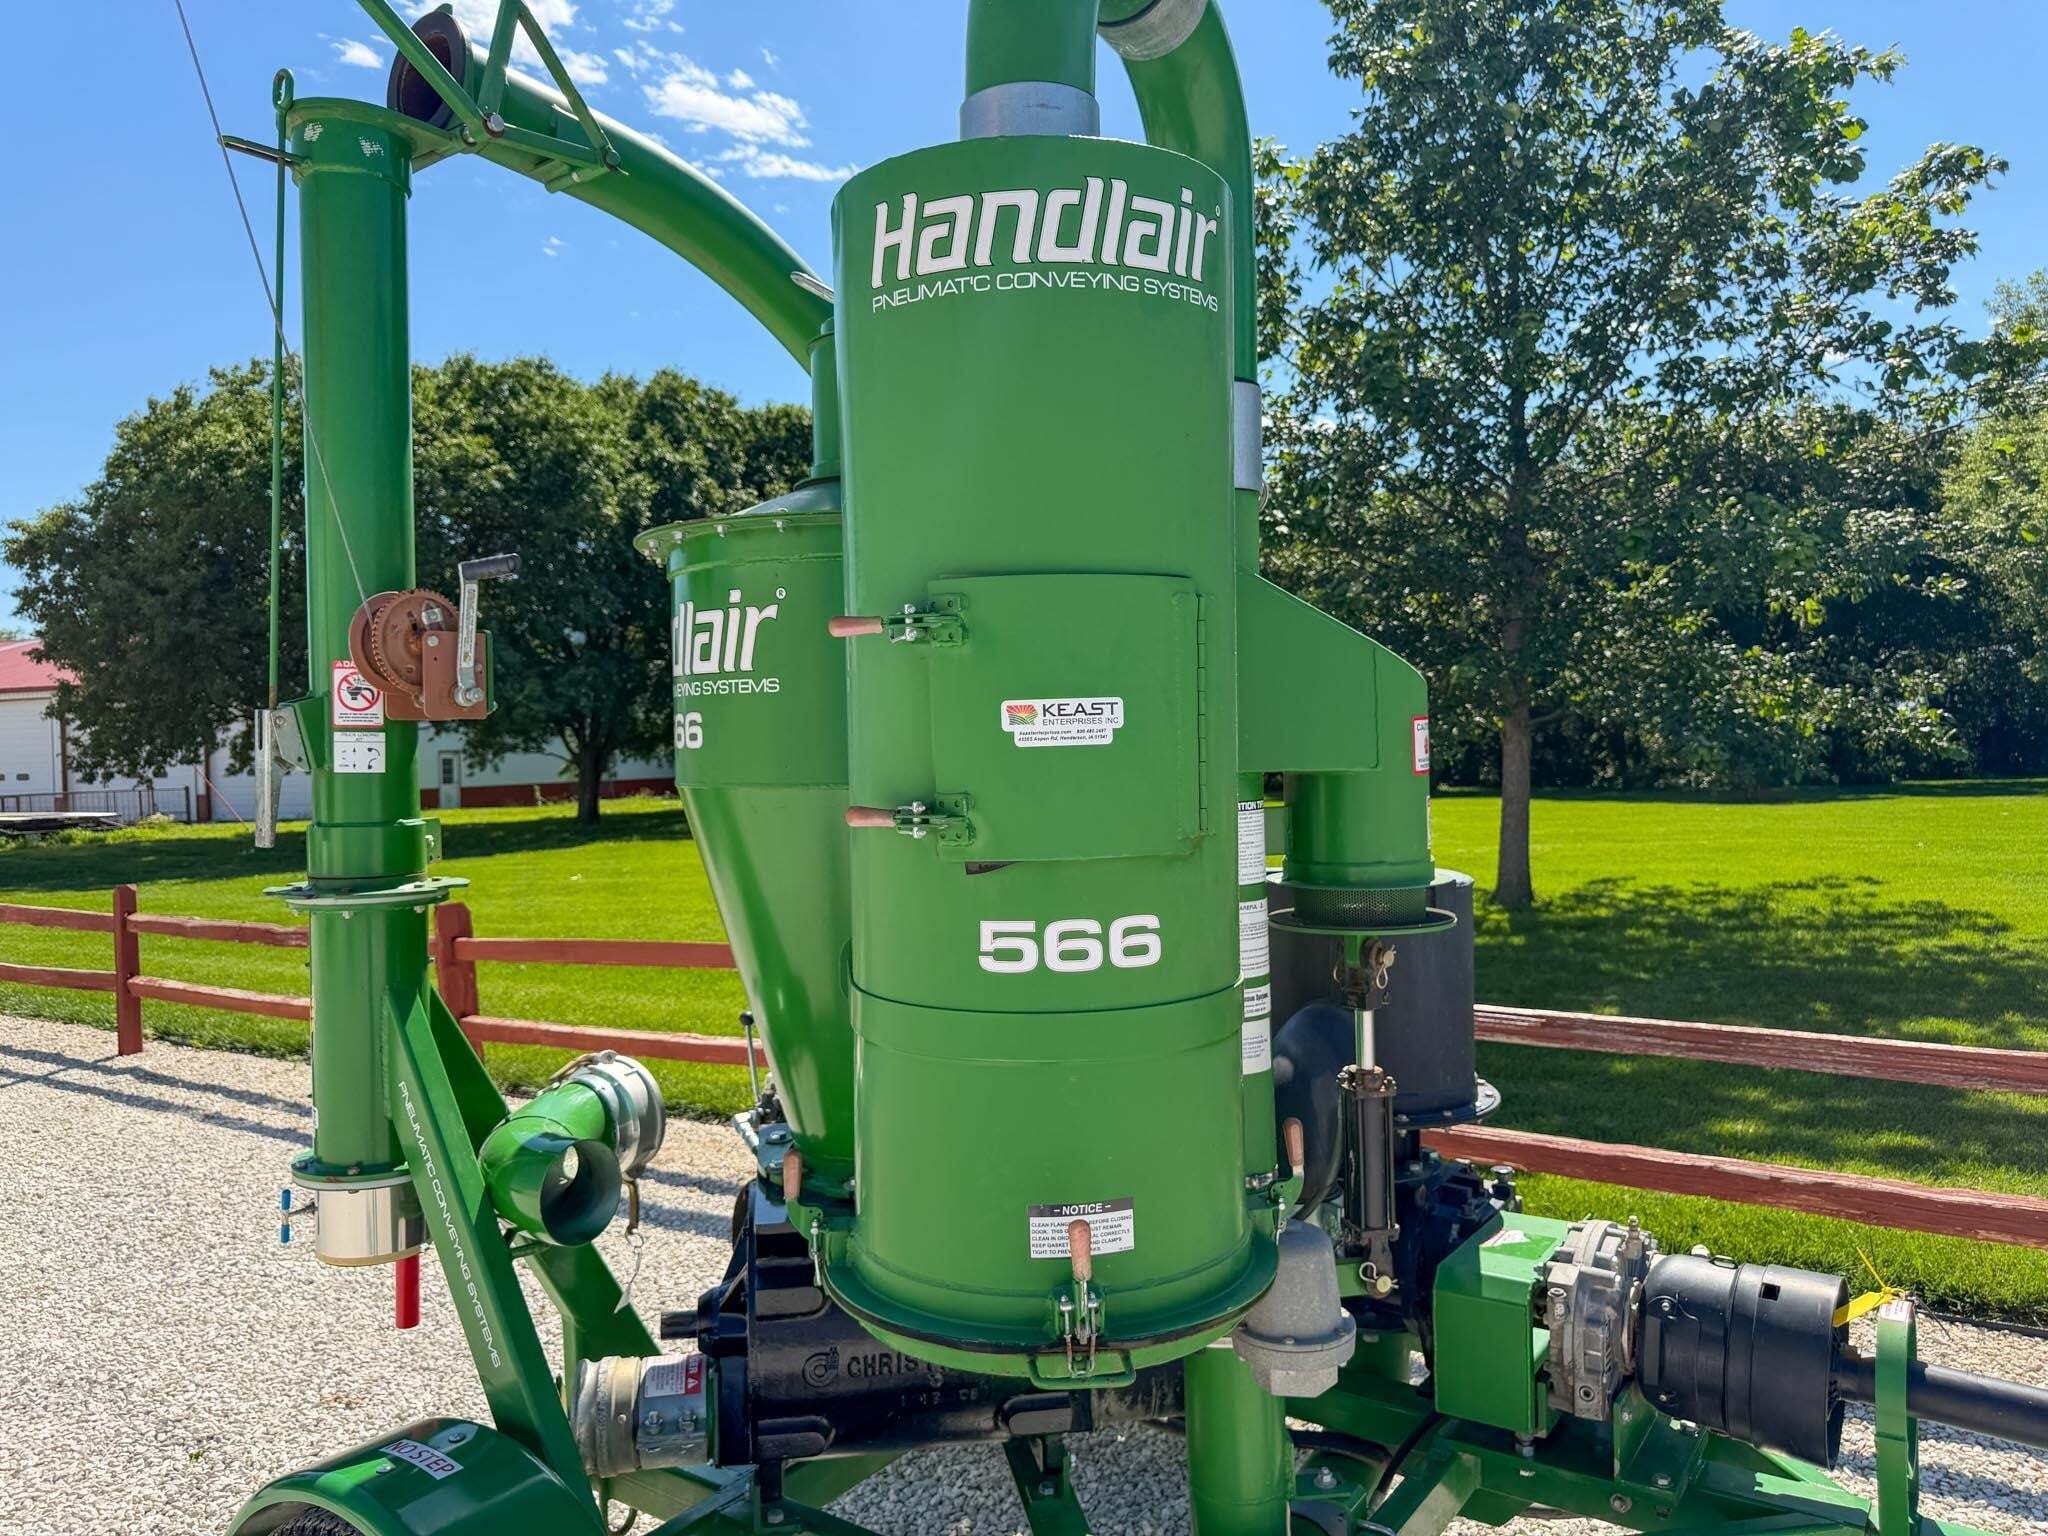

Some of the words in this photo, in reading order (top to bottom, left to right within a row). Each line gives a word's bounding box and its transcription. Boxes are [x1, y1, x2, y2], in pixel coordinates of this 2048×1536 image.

[871, 176, 1217, 288] Handlair
[996, 272, 1140, 291] CONVEYING
[1143, 278, 1218, 312] SYSTEMS
[703, 677, 780, 696] SYSTEMS
[1042, 702, 1119, 717] KEAST
[1042, 717, 1103, 726] ENTERPRISES
[1105, 716, 1119, 724] INC
[978, 914, 1162, 974] 566
[1062, 1203, 1103, 1215] NOTICE
[398, 1081, 436, 1178] PNEUMATIC
[431, 1179, 471, 1281] CONVEYING
[466, 1282, 501, 1369] SYSTEMS
[386, 1442, 418, 1454] NO
[409, 1450, 455, 1472] STEP
